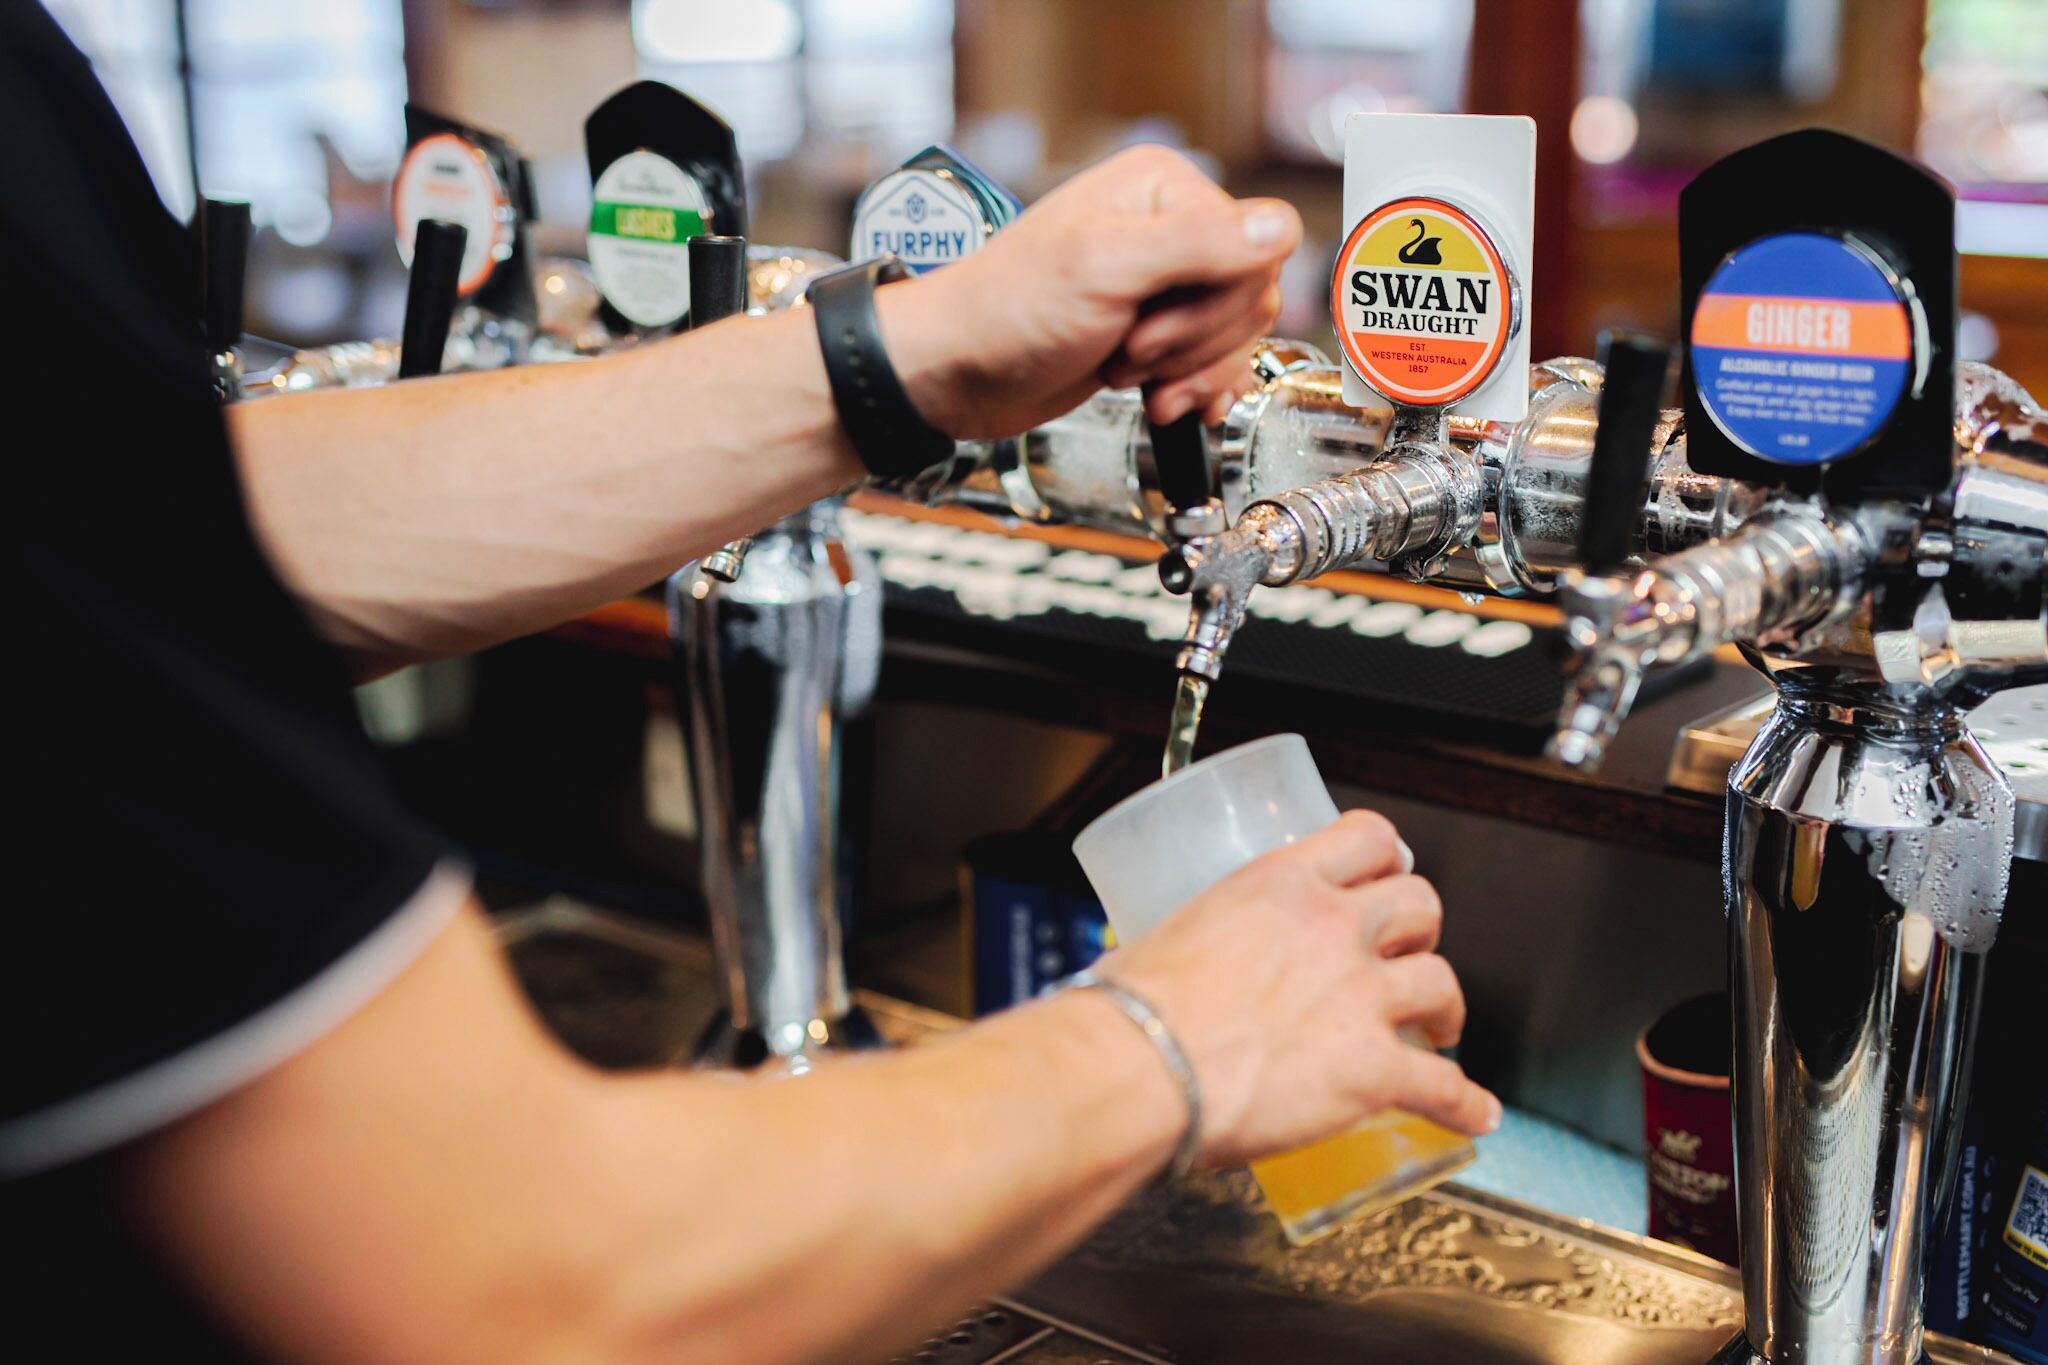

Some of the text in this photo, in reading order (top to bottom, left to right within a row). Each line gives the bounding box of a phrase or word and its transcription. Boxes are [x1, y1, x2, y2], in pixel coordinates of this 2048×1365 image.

[873, 231, 966, 257] FURPHY
[1351, 270, 1491, 314] SWAN
[1362, 311, 1478, 335] DRAUGHT
[1746, 301, 1850, 350] GINGER
[1371, 350, 1467, 366] WESTERN AUSTRALIA
[1409, 342, 1426, 352] EST
[1408, 364, 1429, 373] 1857
[1719, 357, 1788, 377] ALCOHOLIC
